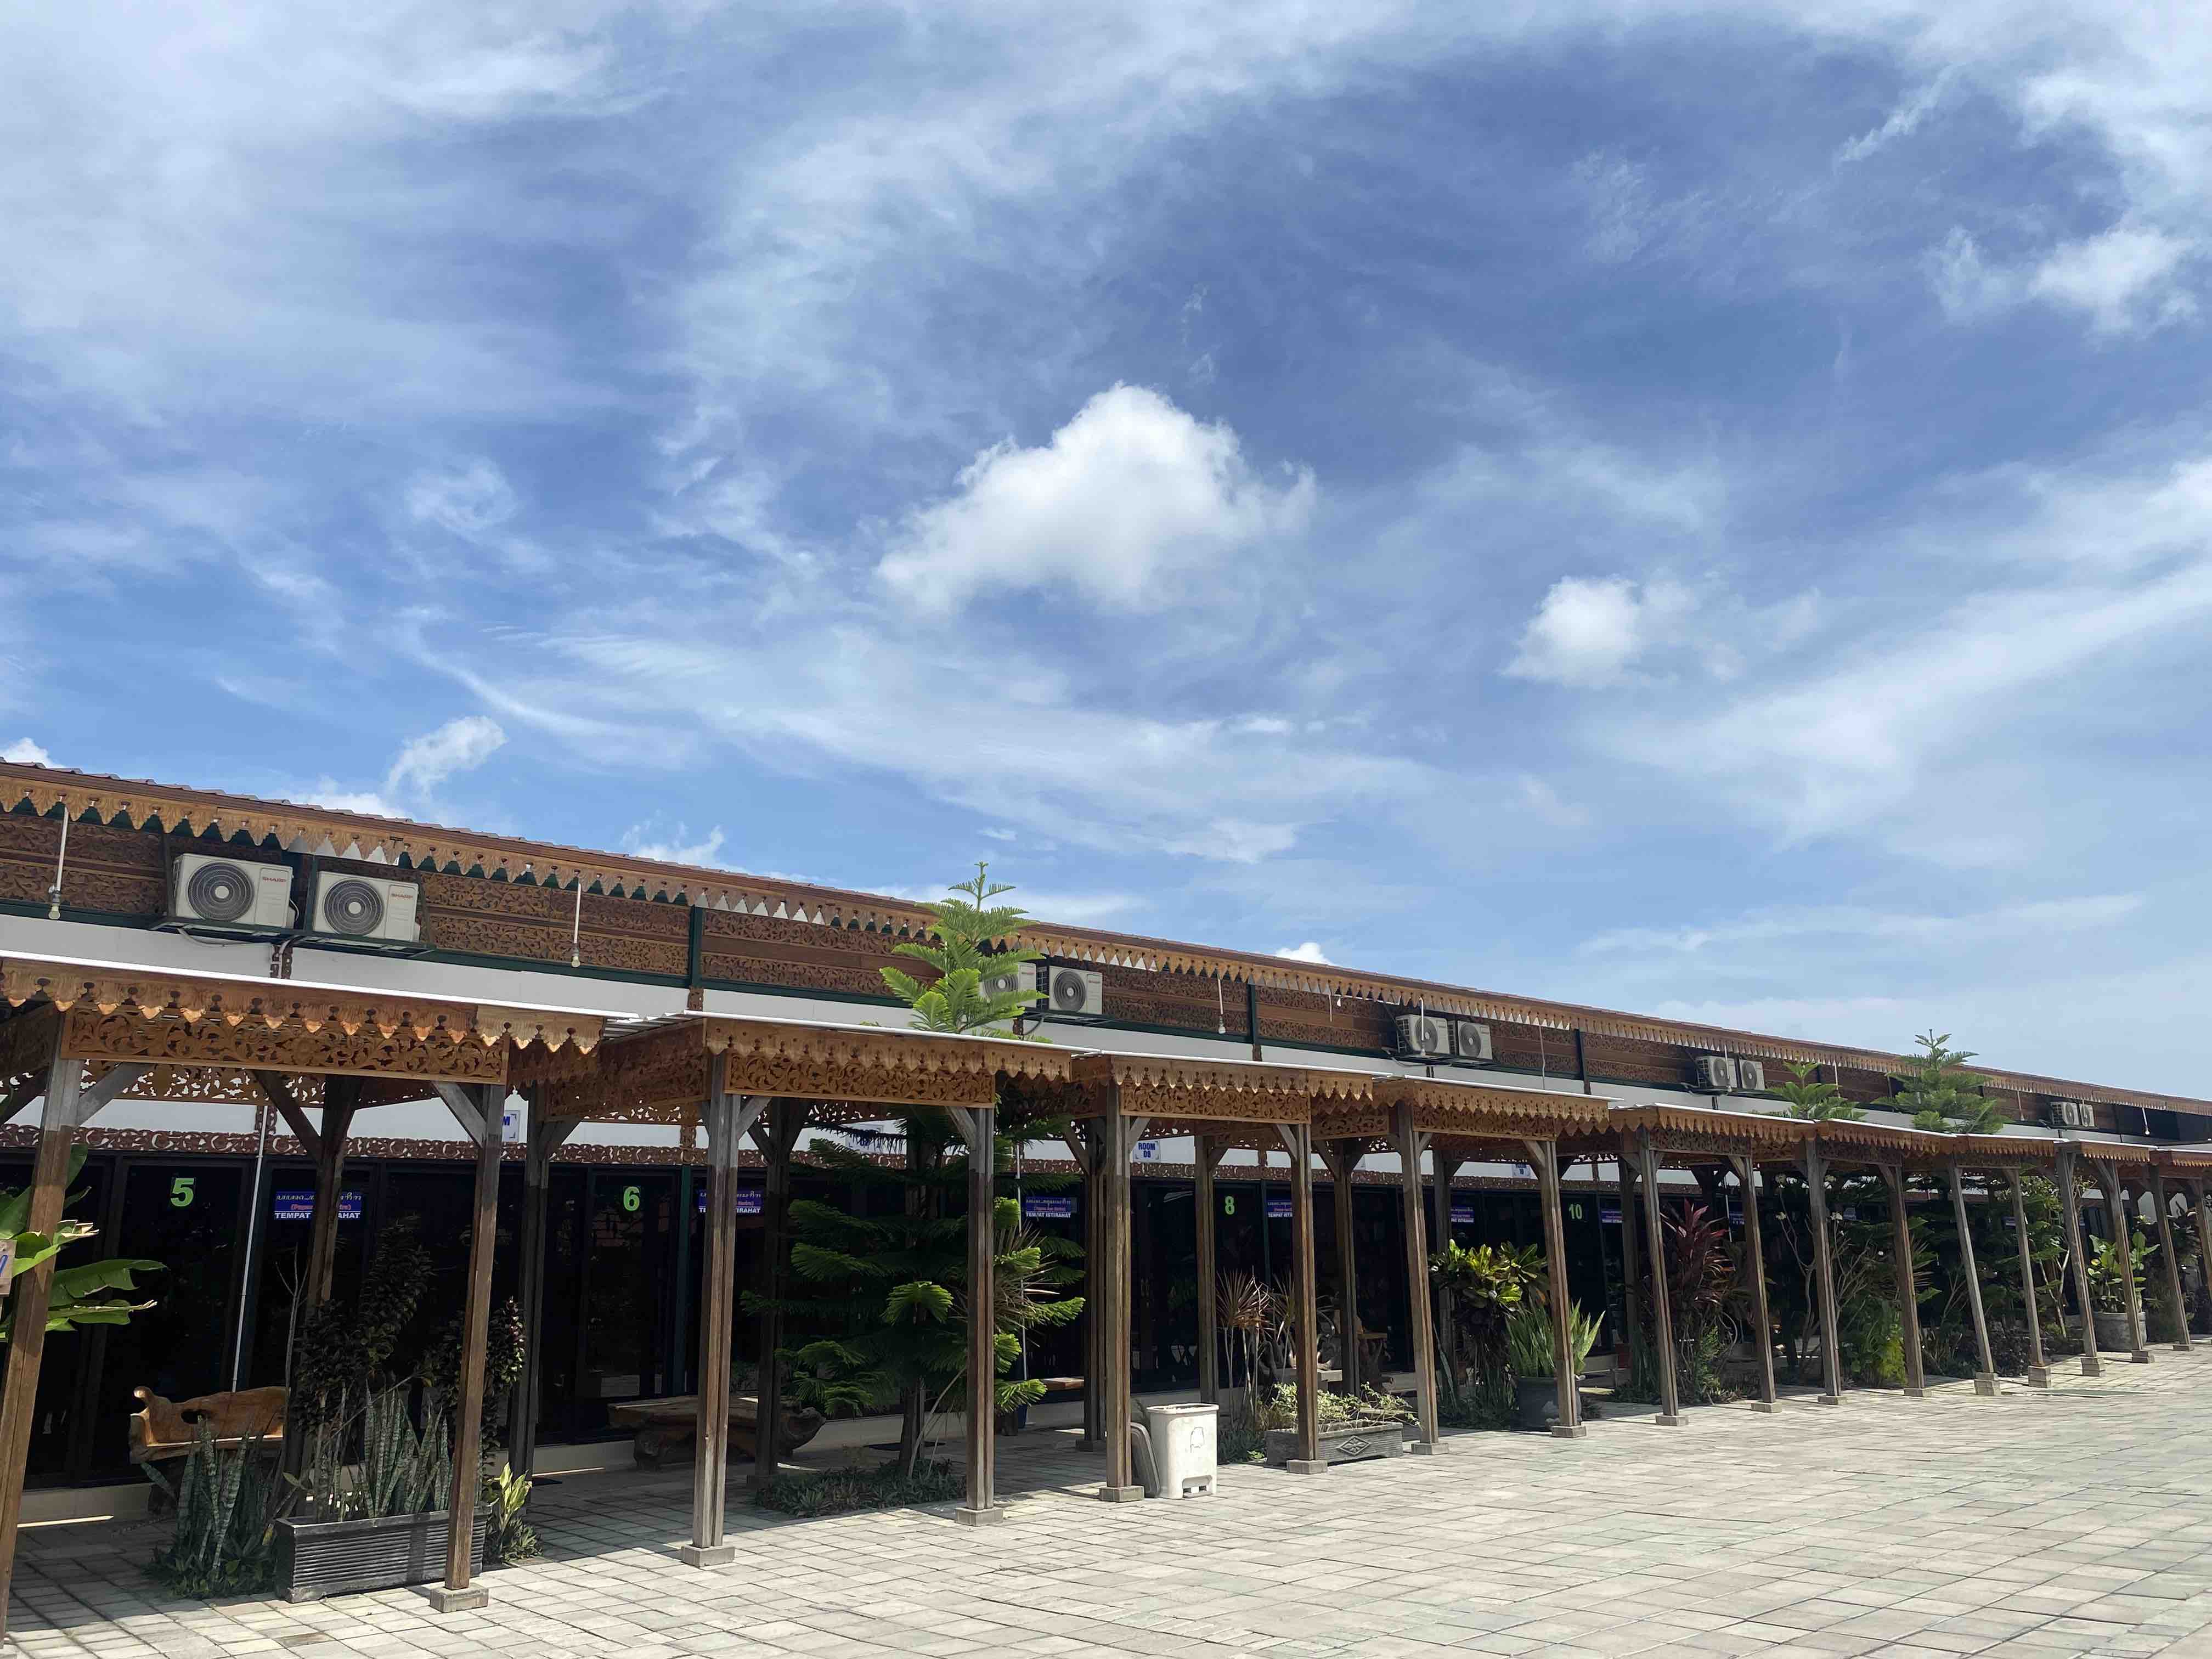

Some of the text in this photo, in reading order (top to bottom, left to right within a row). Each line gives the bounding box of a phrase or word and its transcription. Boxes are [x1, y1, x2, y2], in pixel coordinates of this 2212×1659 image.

[171, 1177, 194, 1207] 5
[623, 1186, 640, 1211] 6
[1225, 1196, 1234, 1215] 8
[1568, 1204, 1582, 1219] 10
